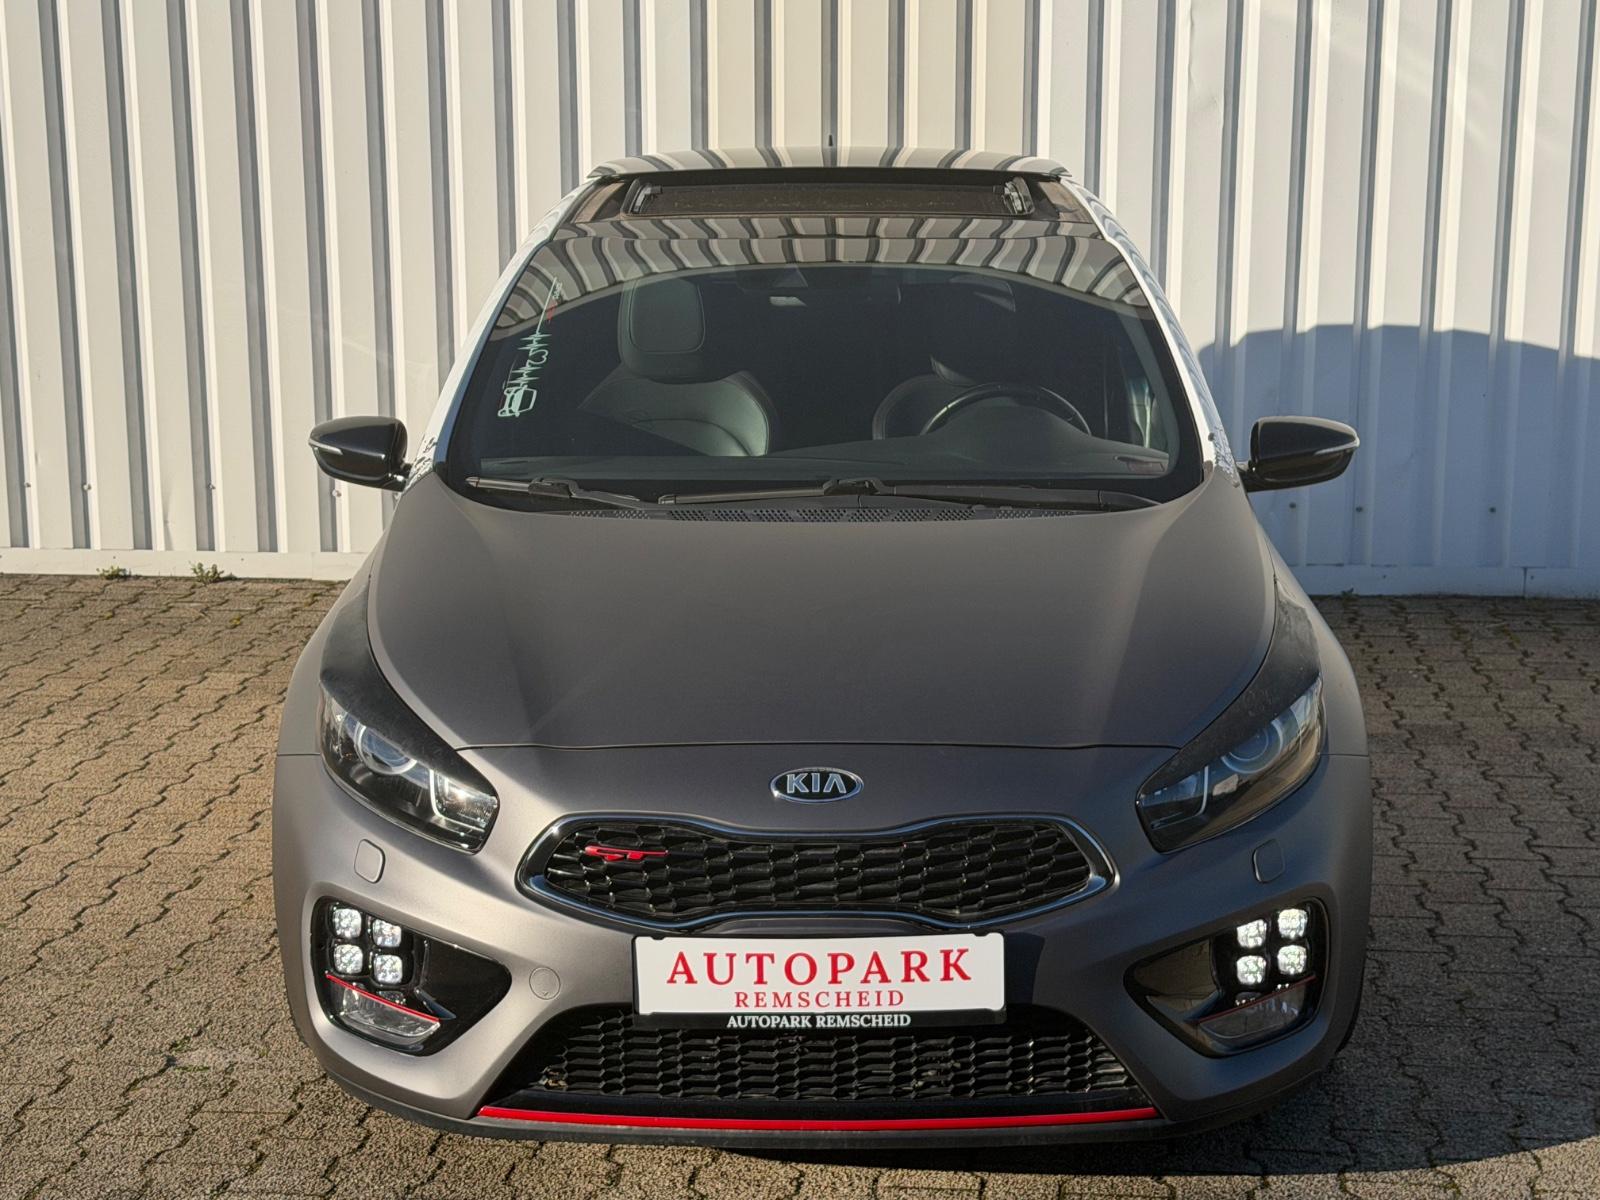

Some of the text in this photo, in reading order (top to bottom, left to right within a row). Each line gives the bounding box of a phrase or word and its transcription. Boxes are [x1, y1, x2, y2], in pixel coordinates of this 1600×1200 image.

[786, 772, 847, 794] KIA
[666, 948, 972, 986] AUTOPARK
[734, 989, 905, 1009] REMSCHEID
[726, 1013, 912, 1030] AUTOPARK REMSCHEID
